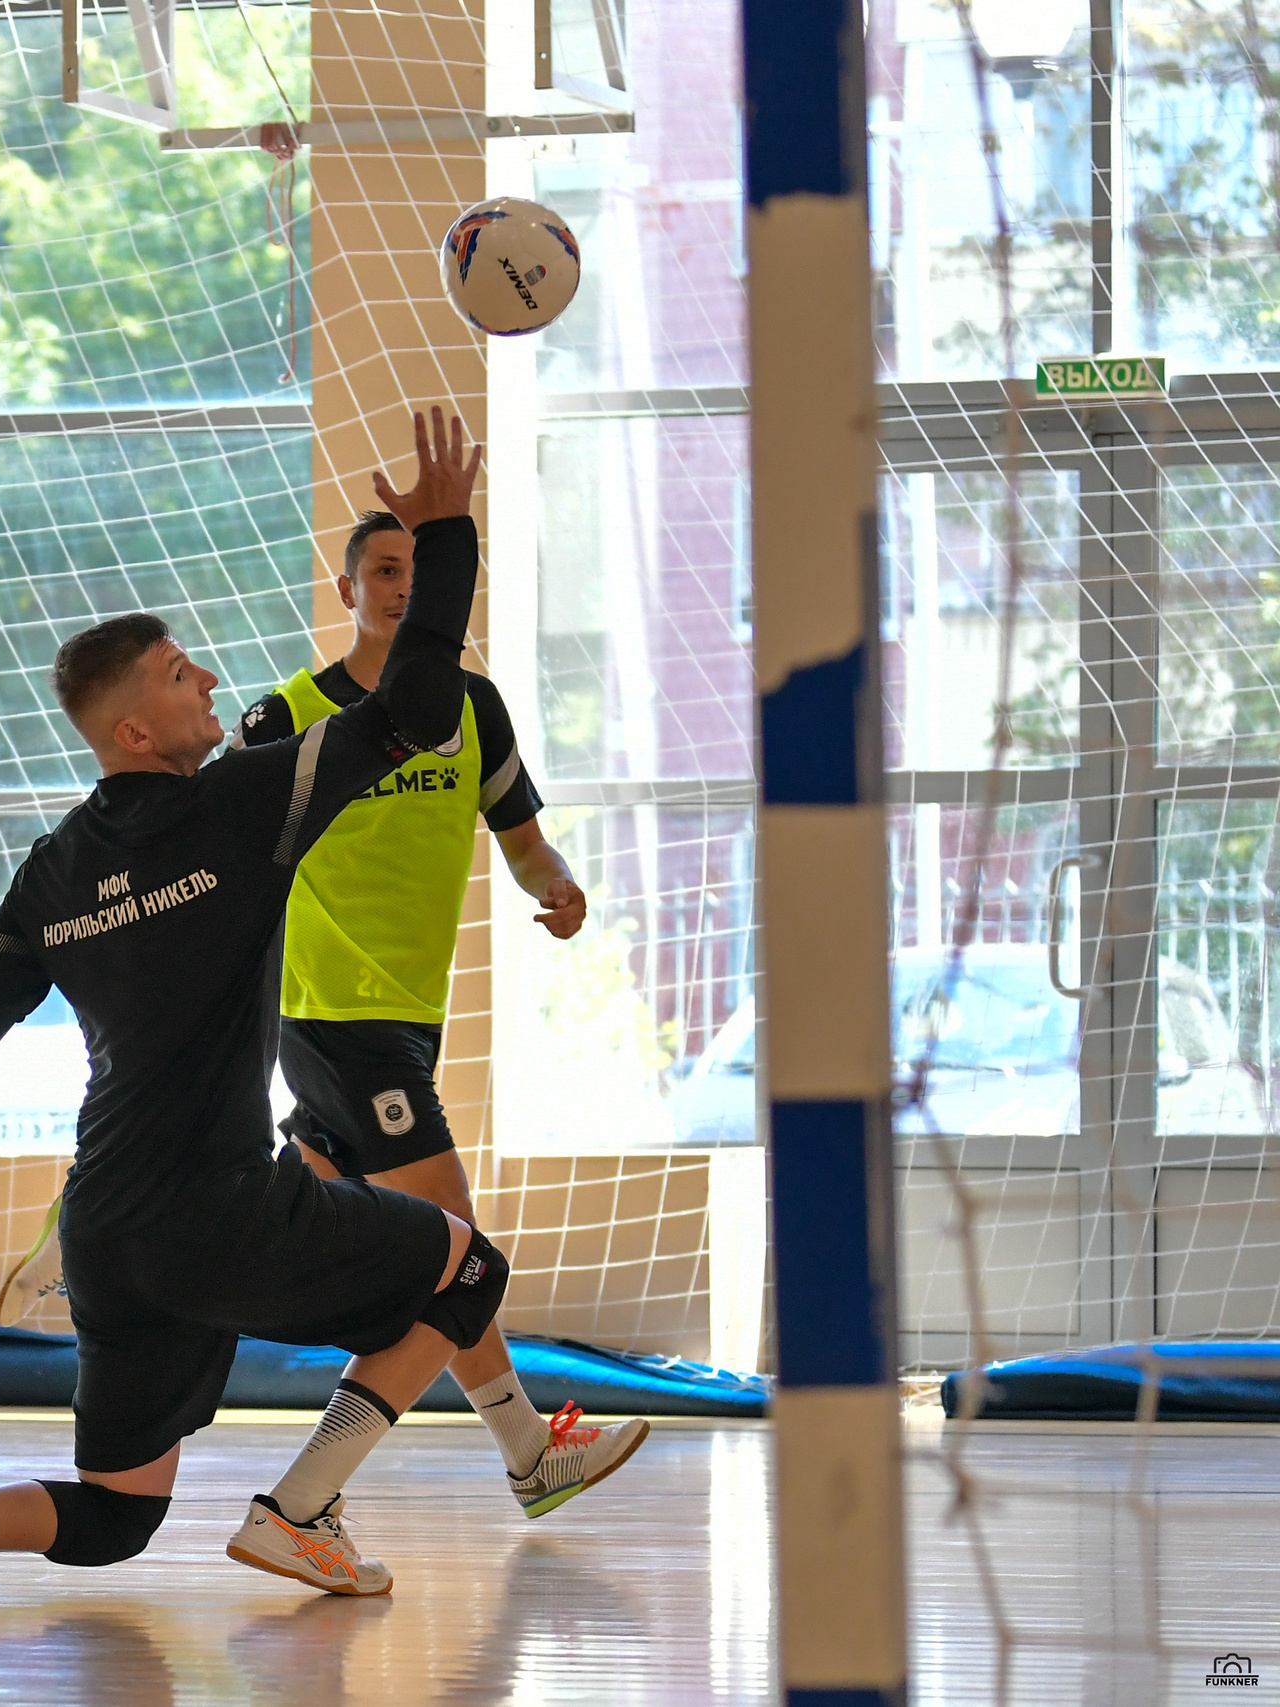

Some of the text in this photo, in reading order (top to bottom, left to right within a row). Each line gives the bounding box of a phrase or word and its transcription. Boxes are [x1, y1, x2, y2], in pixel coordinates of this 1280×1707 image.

[497, 257, 538, 310] DEMIX
[1046, 362, 1156, 388] ВЫХОД
[97, 870, 131, 902] МФК
[43, 869, 218, 947] НОРИЛЬСКИЙ НИКЕЛЬ
[460, 1255, 479, 1284] SHEVA
